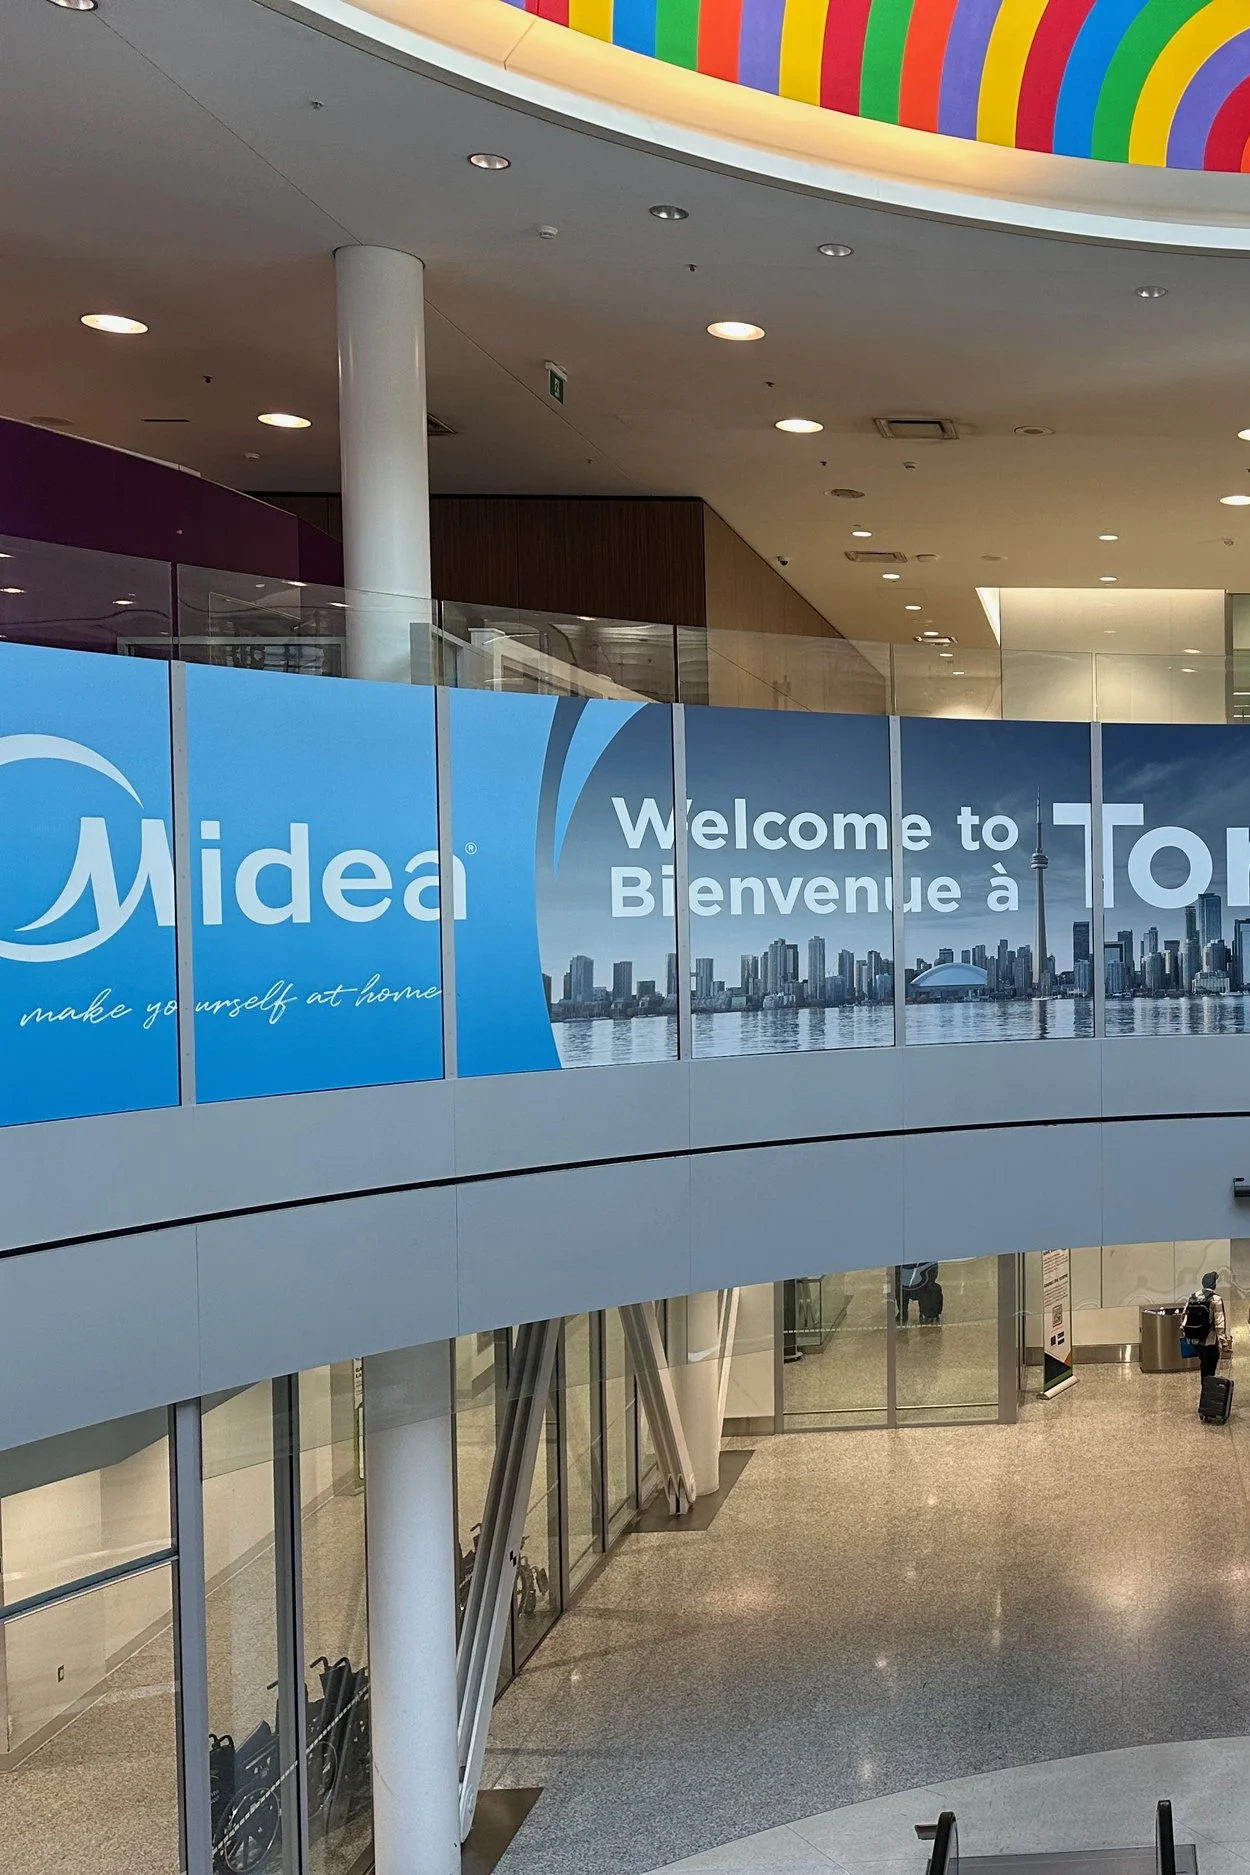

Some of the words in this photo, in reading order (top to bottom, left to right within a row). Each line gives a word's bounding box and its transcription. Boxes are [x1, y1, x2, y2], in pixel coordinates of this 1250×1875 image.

[611, 797, 931, 851] Welcome
[957, 806, 1019, 851] to
[611, 866, 962, 918] Bienvenue
[986, 863, 1019, 912] à
[19, 988, 132, 1027] make
[142, 980, 298, 1029] yourself
[305, 985, 357, 1007] at
[357, 974, 442, 1006] home
